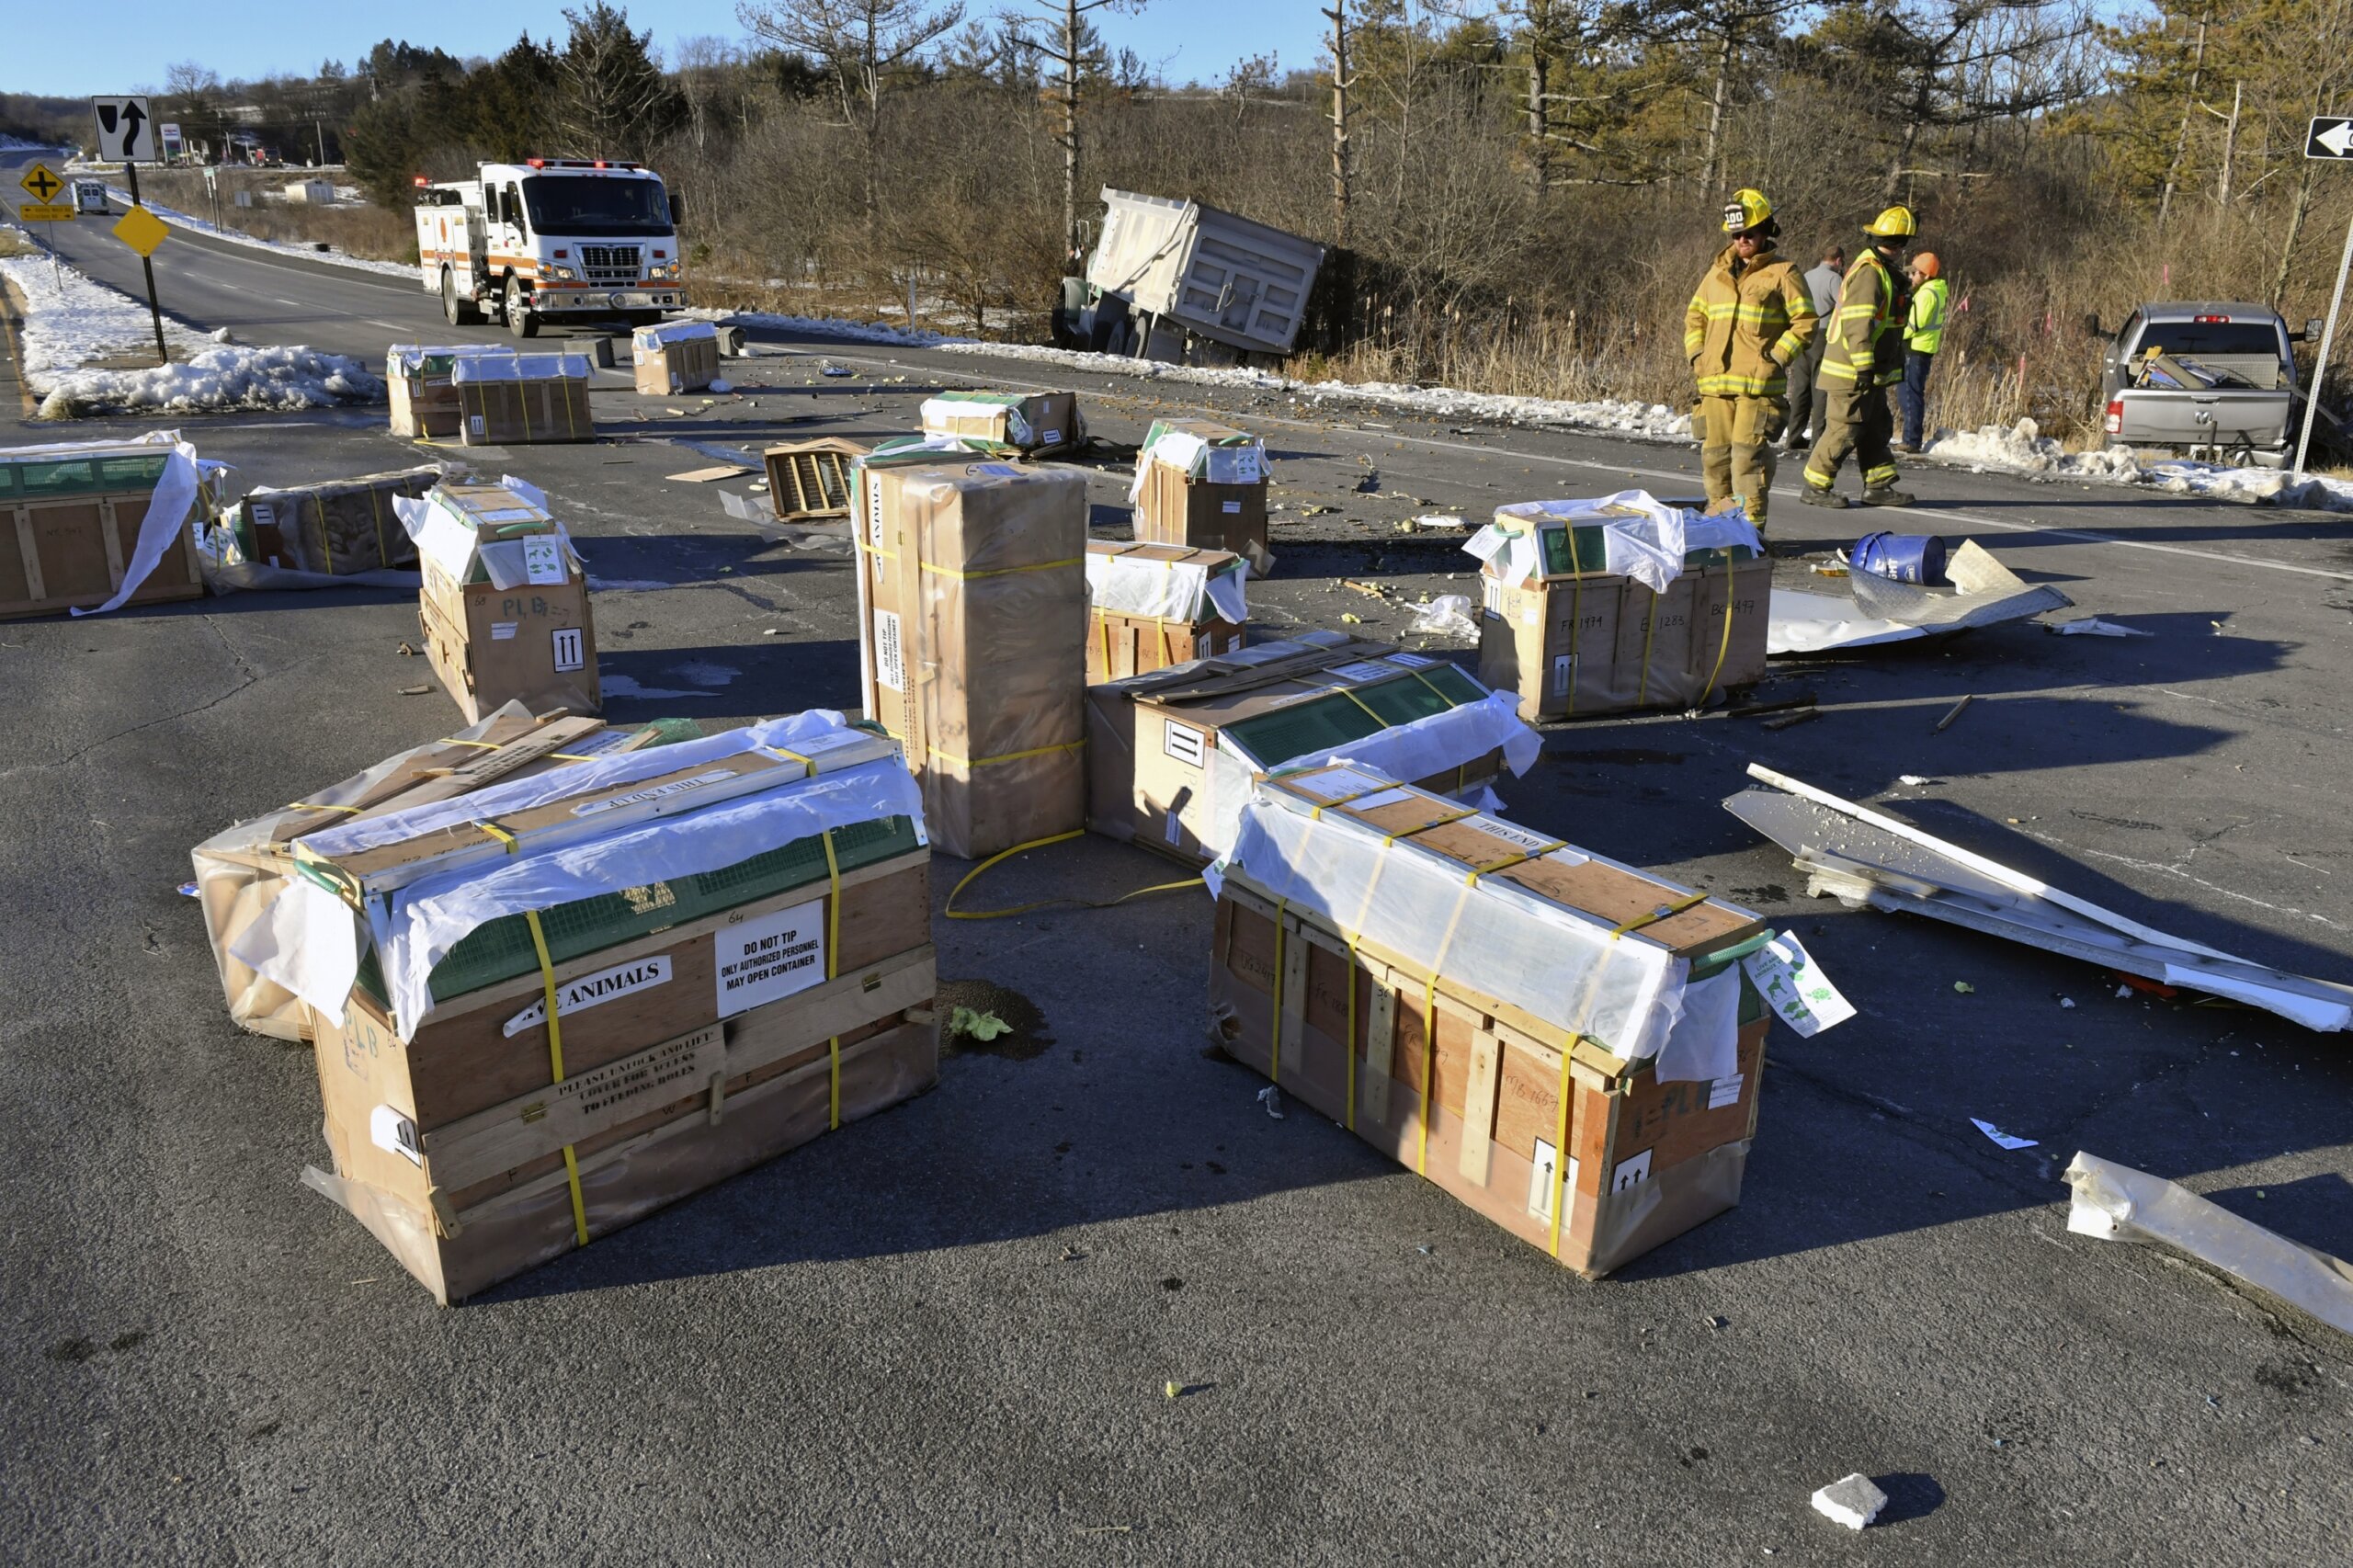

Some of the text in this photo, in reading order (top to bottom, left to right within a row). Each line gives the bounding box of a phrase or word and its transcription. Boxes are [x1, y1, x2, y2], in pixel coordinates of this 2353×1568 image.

[1725, 211, 1744, 224] 100
[609, 778, 706, 807] THIS END UP
[1479, 823, 1540, 847] THIS END
[728, 910, 744, 924] 64
[721, 939, 819, 978] ONLY AUTHORIZED PERSONNEL
[744, 929, 797, 956] DO NOT TIP
[567, 962, 659, 1006] ANIMALS
[727, 954, 815, 991] MAY OPEN CONTAINER
[559, 1071, 608, 1096] PLEASE
[661, 1044, 682, 1057] AND
[685, 1031, 714, 1049] LIFT
[603, 1079, 655, 1106] FEEDING
[657, 1065, 695, 1085] HOLES
